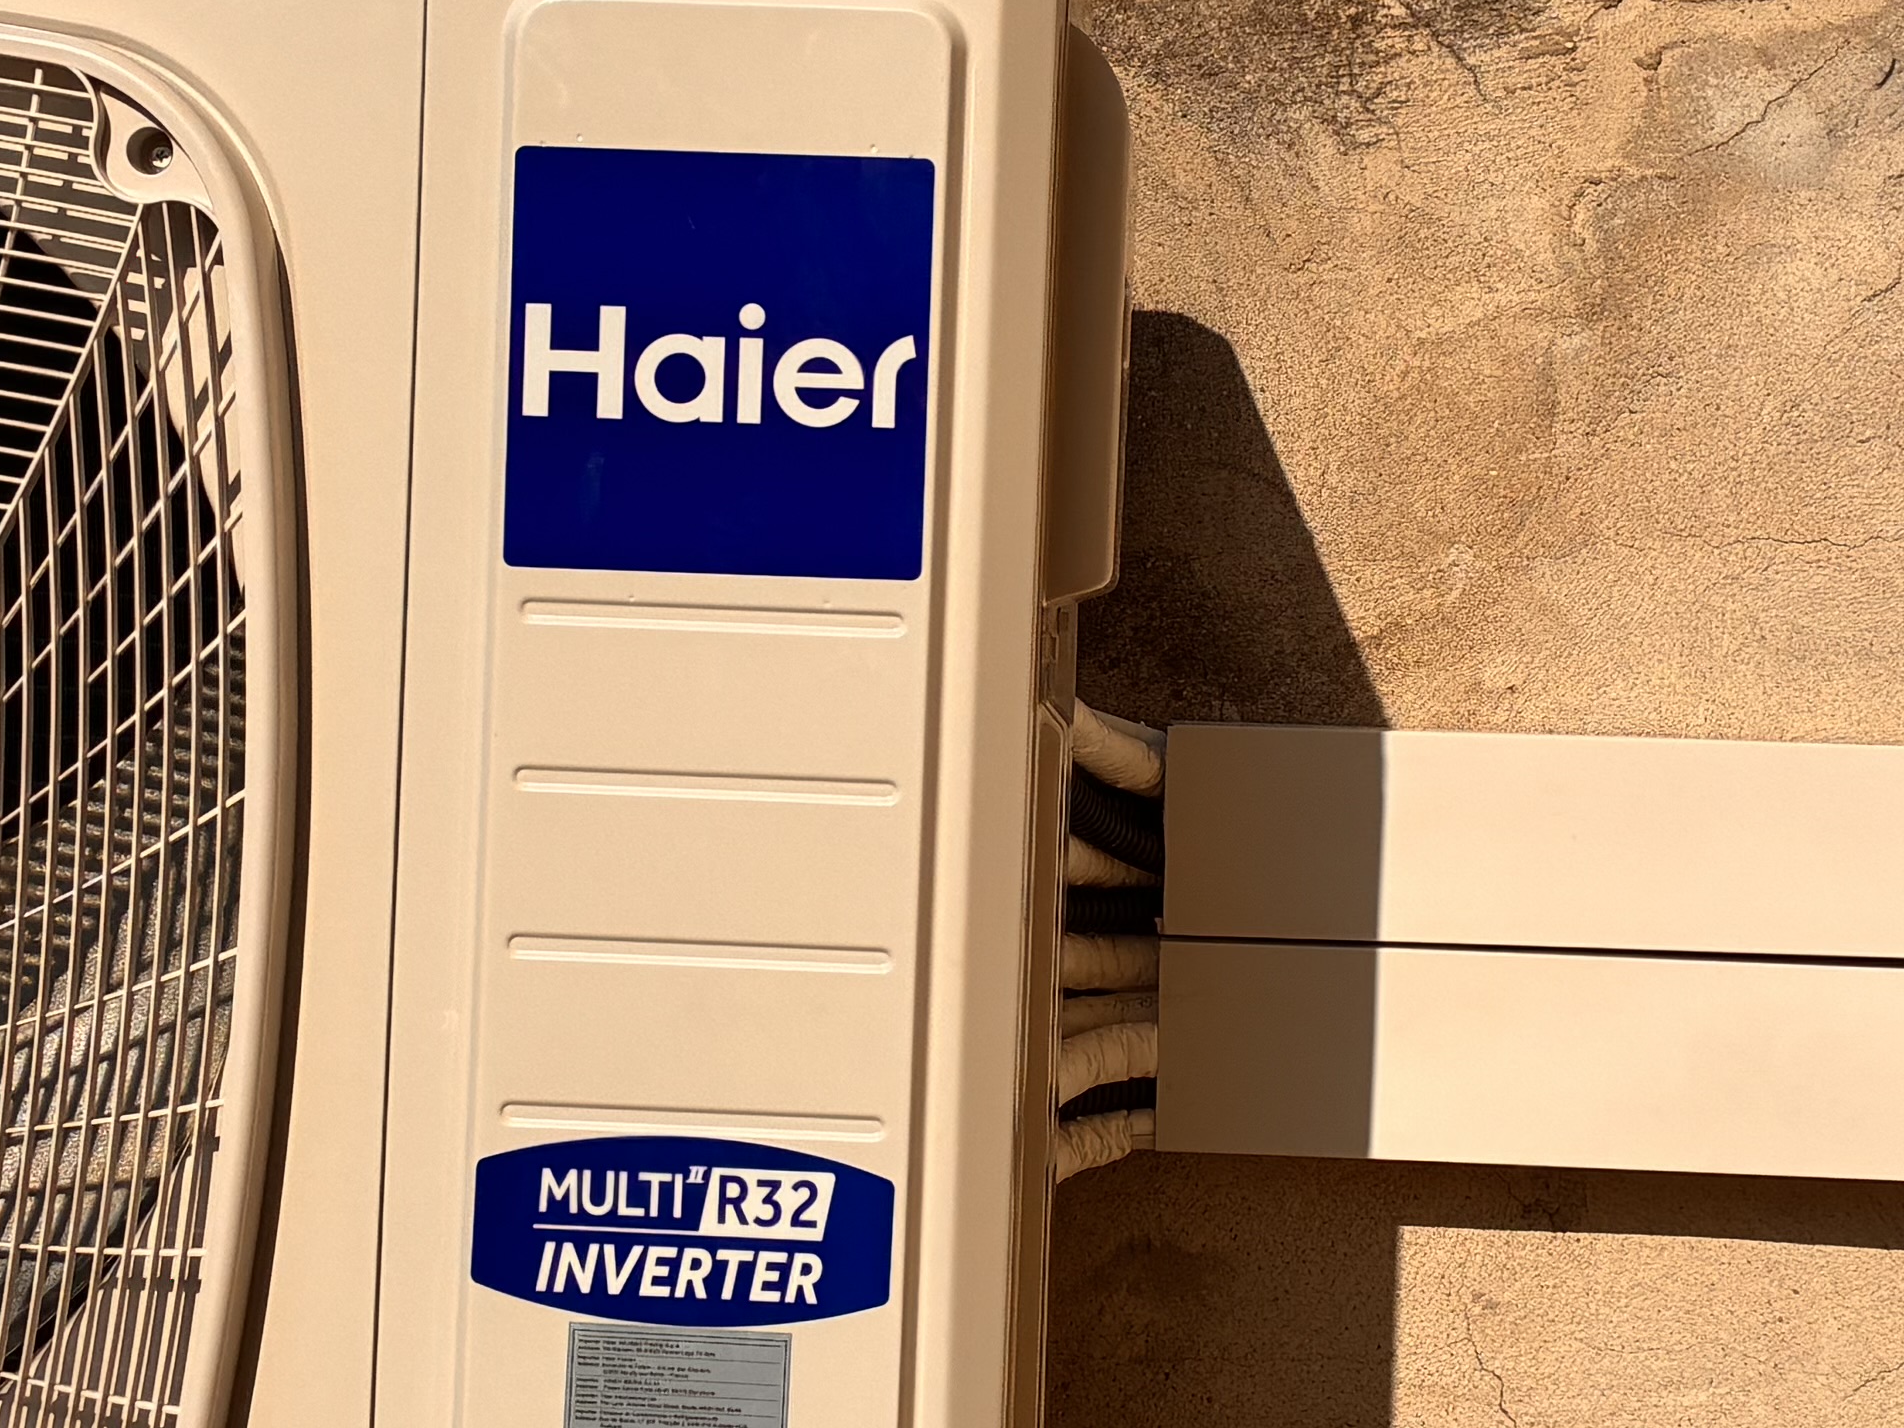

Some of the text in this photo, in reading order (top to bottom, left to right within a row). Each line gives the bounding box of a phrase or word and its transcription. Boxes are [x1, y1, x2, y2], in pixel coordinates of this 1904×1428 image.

[522, 303, 916, 428] Haier
[718, 1175, 817, 1228] R32
[536, 1242, 822, 1304] INVERTER
